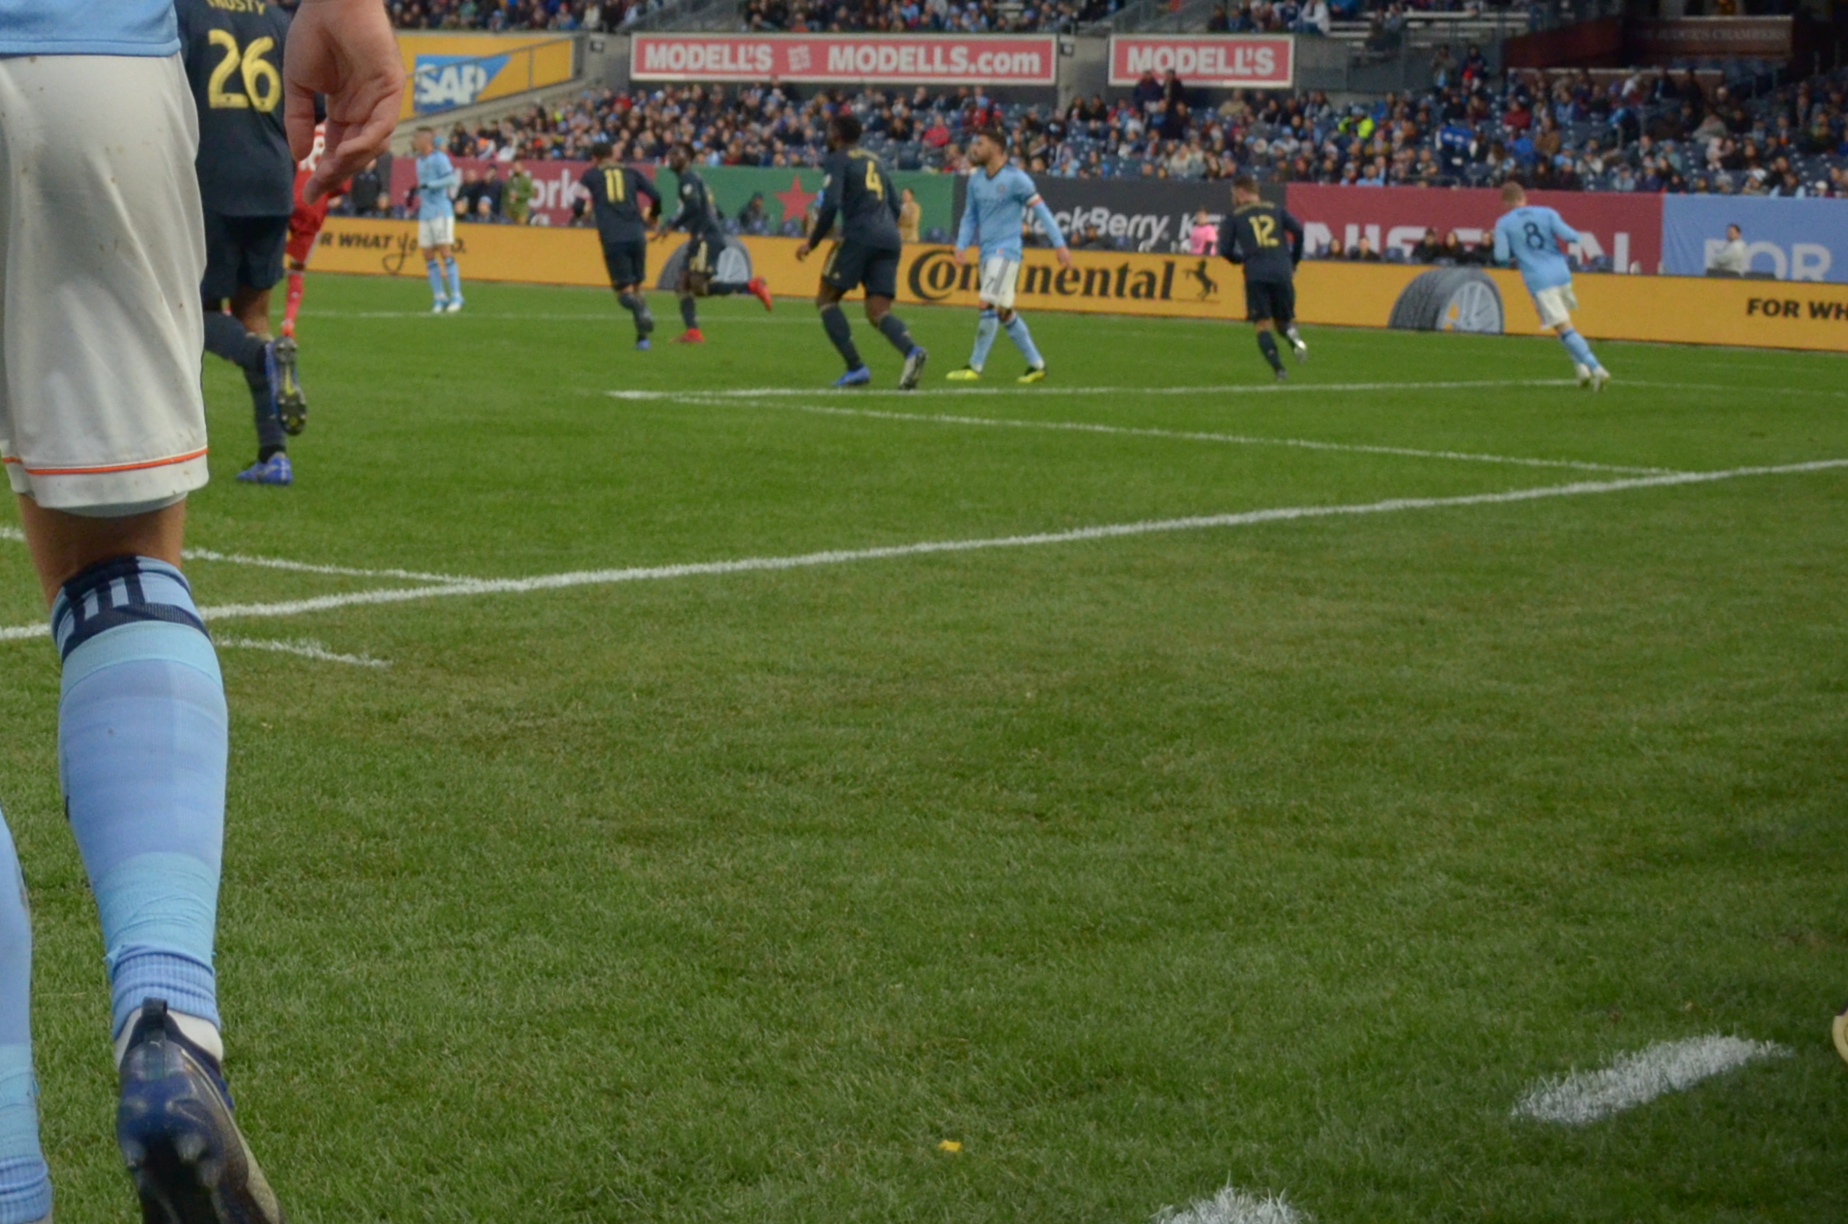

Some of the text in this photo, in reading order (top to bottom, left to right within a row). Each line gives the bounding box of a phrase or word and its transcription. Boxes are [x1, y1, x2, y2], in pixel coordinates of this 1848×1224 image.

[208, 29, 282, 113] 26
[645, 42, 773, 72] MODELL'S
[828, 45, 1041, 74] MODELLS.com
[1128, 45, 1274, 75] MODELL'S
[414, 62, 487, 104] SAP
[529, 168, 579, 209] ork
[605, 168, 625, 203] 11
[865, 161, 883, 201] 4
[1022, 205, 1170, 246] lackBerry
[1249, 215, 1280, 248] 12
[1524, 222, 1545, 251] 8
[340, 233, 392, 249] WHAT
[382, 233, 418, 275] yo
[908, 249, 1175, 301] Connental
[1746, 298, 1800, 318] FOR
